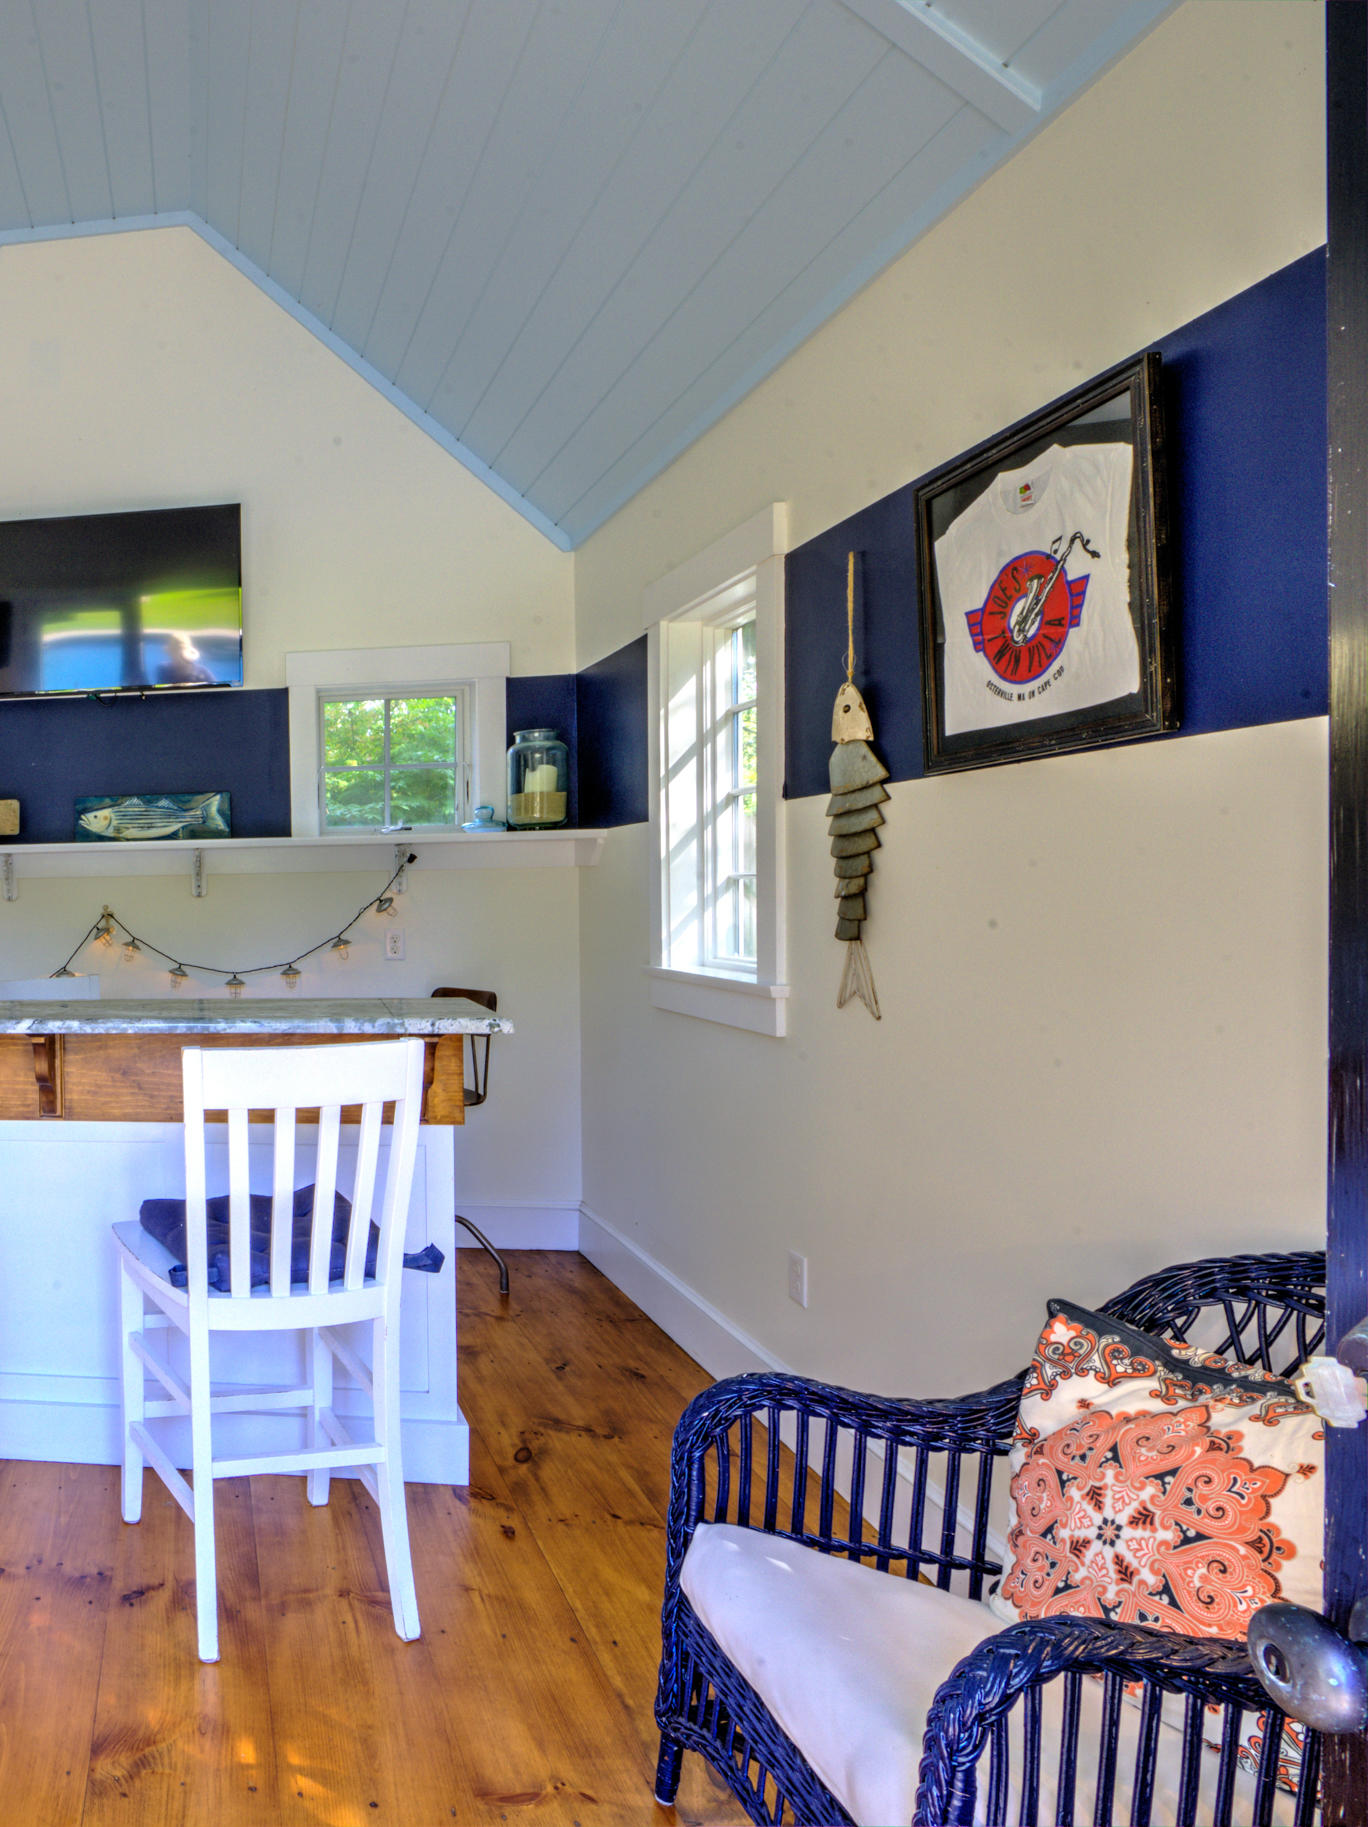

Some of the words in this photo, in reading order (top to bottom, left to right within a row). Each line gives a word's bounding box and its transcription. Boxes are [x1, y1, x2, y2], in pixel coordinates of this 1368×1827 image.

[987, 629, 1022, 676] TWIN
[1028, 616, 1065, 673] VILLA
[1037, 678, 1052, 695] CAPE
